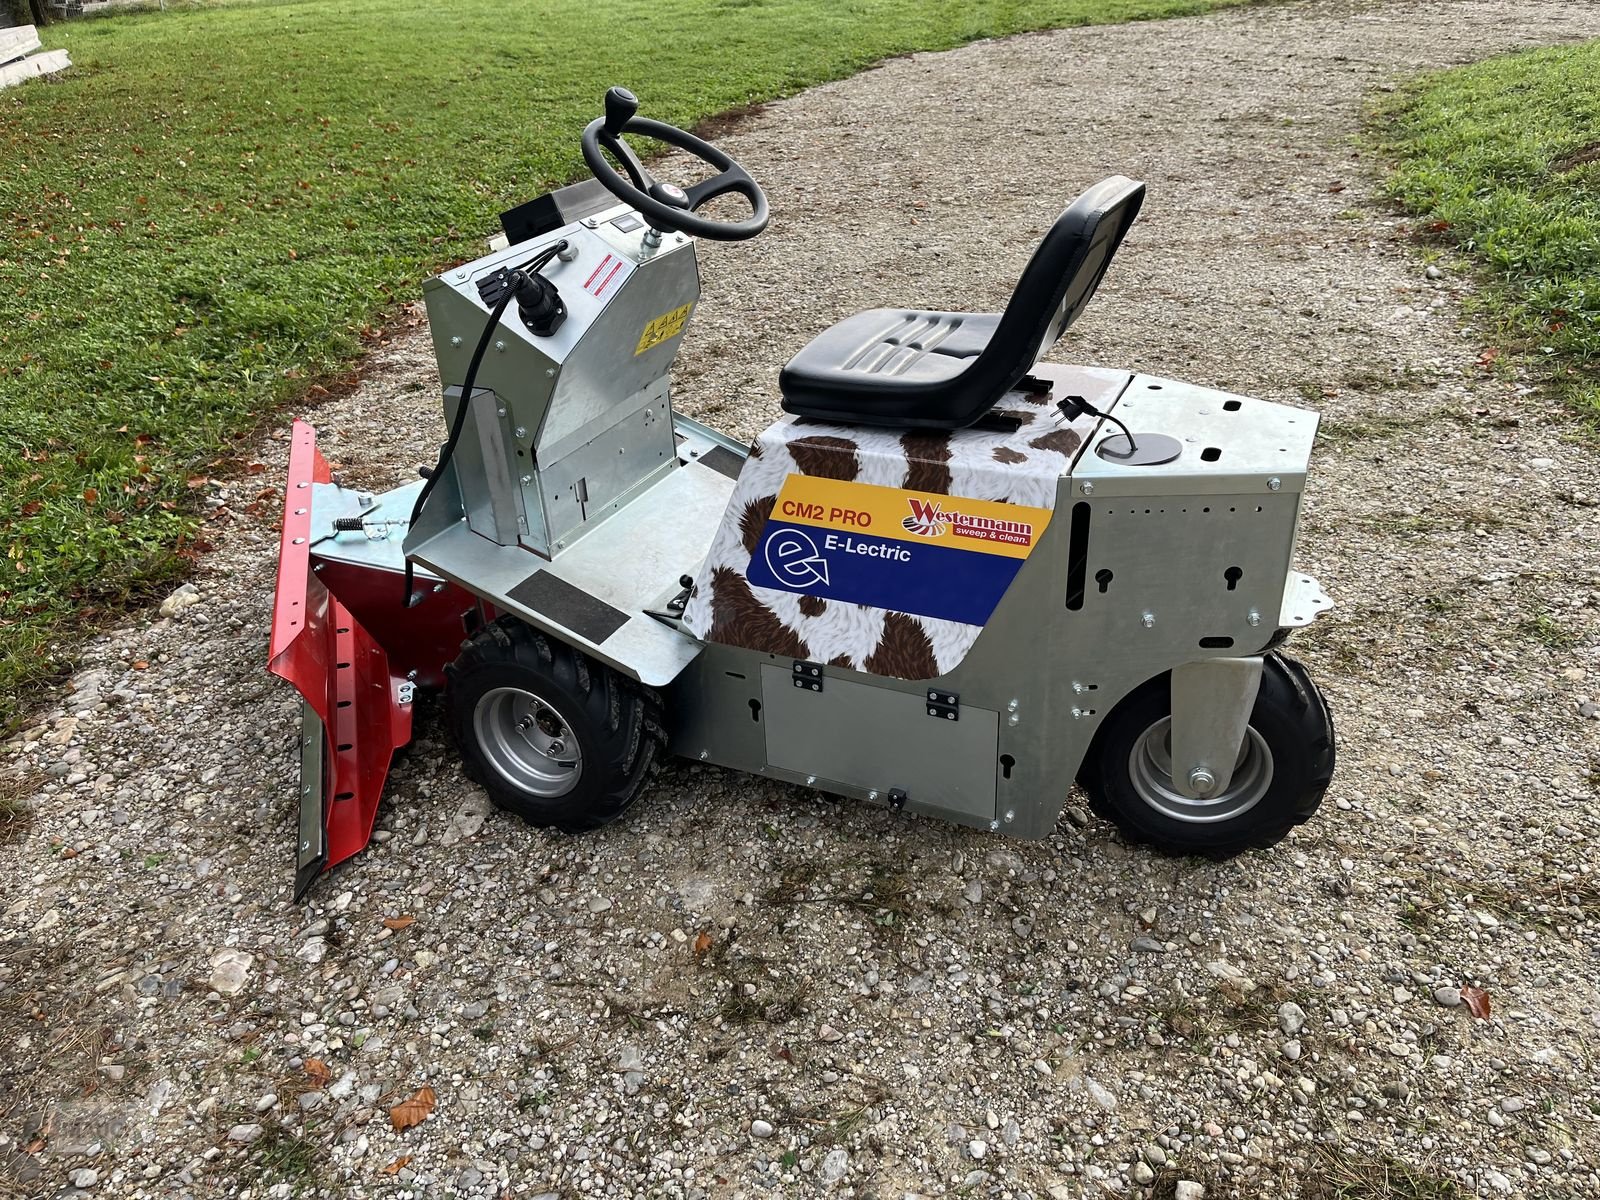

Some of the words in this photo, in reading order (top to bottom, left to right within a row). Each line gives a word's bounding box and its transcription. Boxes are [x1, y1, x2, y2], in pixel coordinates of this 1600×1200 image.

[782, 501, 825, 520] CM2
[829, 507, 872, 527] PRO
[907, 498, 1032, 535] Westermann
[824, 534, 911, 562] E-Lectric
[955, 527, 987, 539] sweep
[989, 531, 997, 539] &
[999, 532, 1028, 544] clean.
